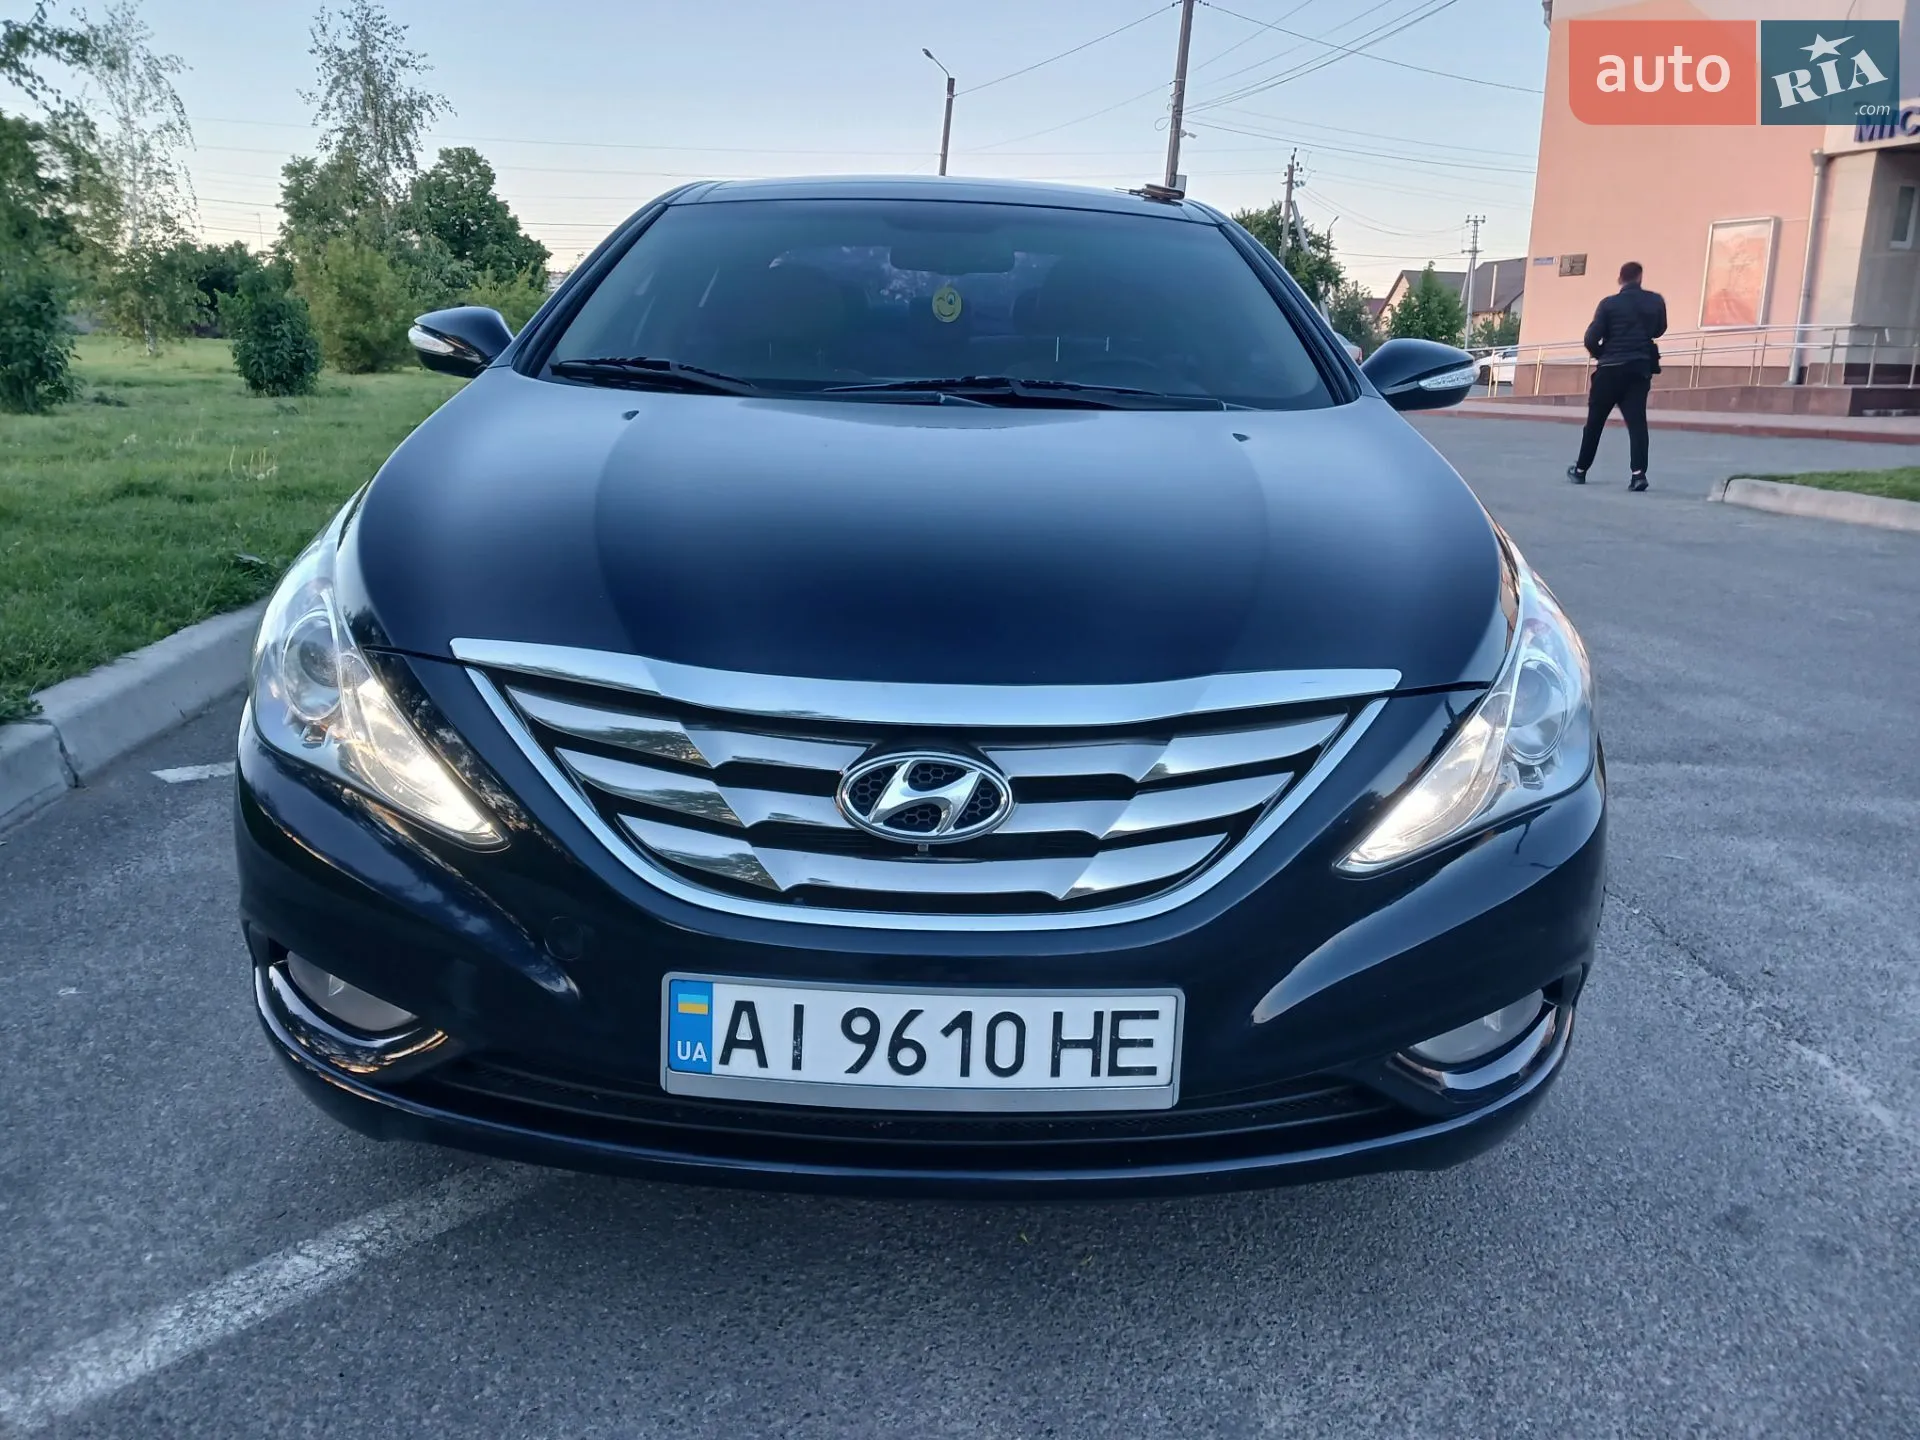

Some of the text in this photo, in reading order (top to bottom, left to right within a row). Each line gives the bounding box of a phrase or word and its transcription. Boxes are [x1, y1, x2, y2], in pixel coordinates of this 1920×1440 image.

[676, 1040, 708, 1063] UA
[718, 1000, 1160, 1078] AI 9610 HE
